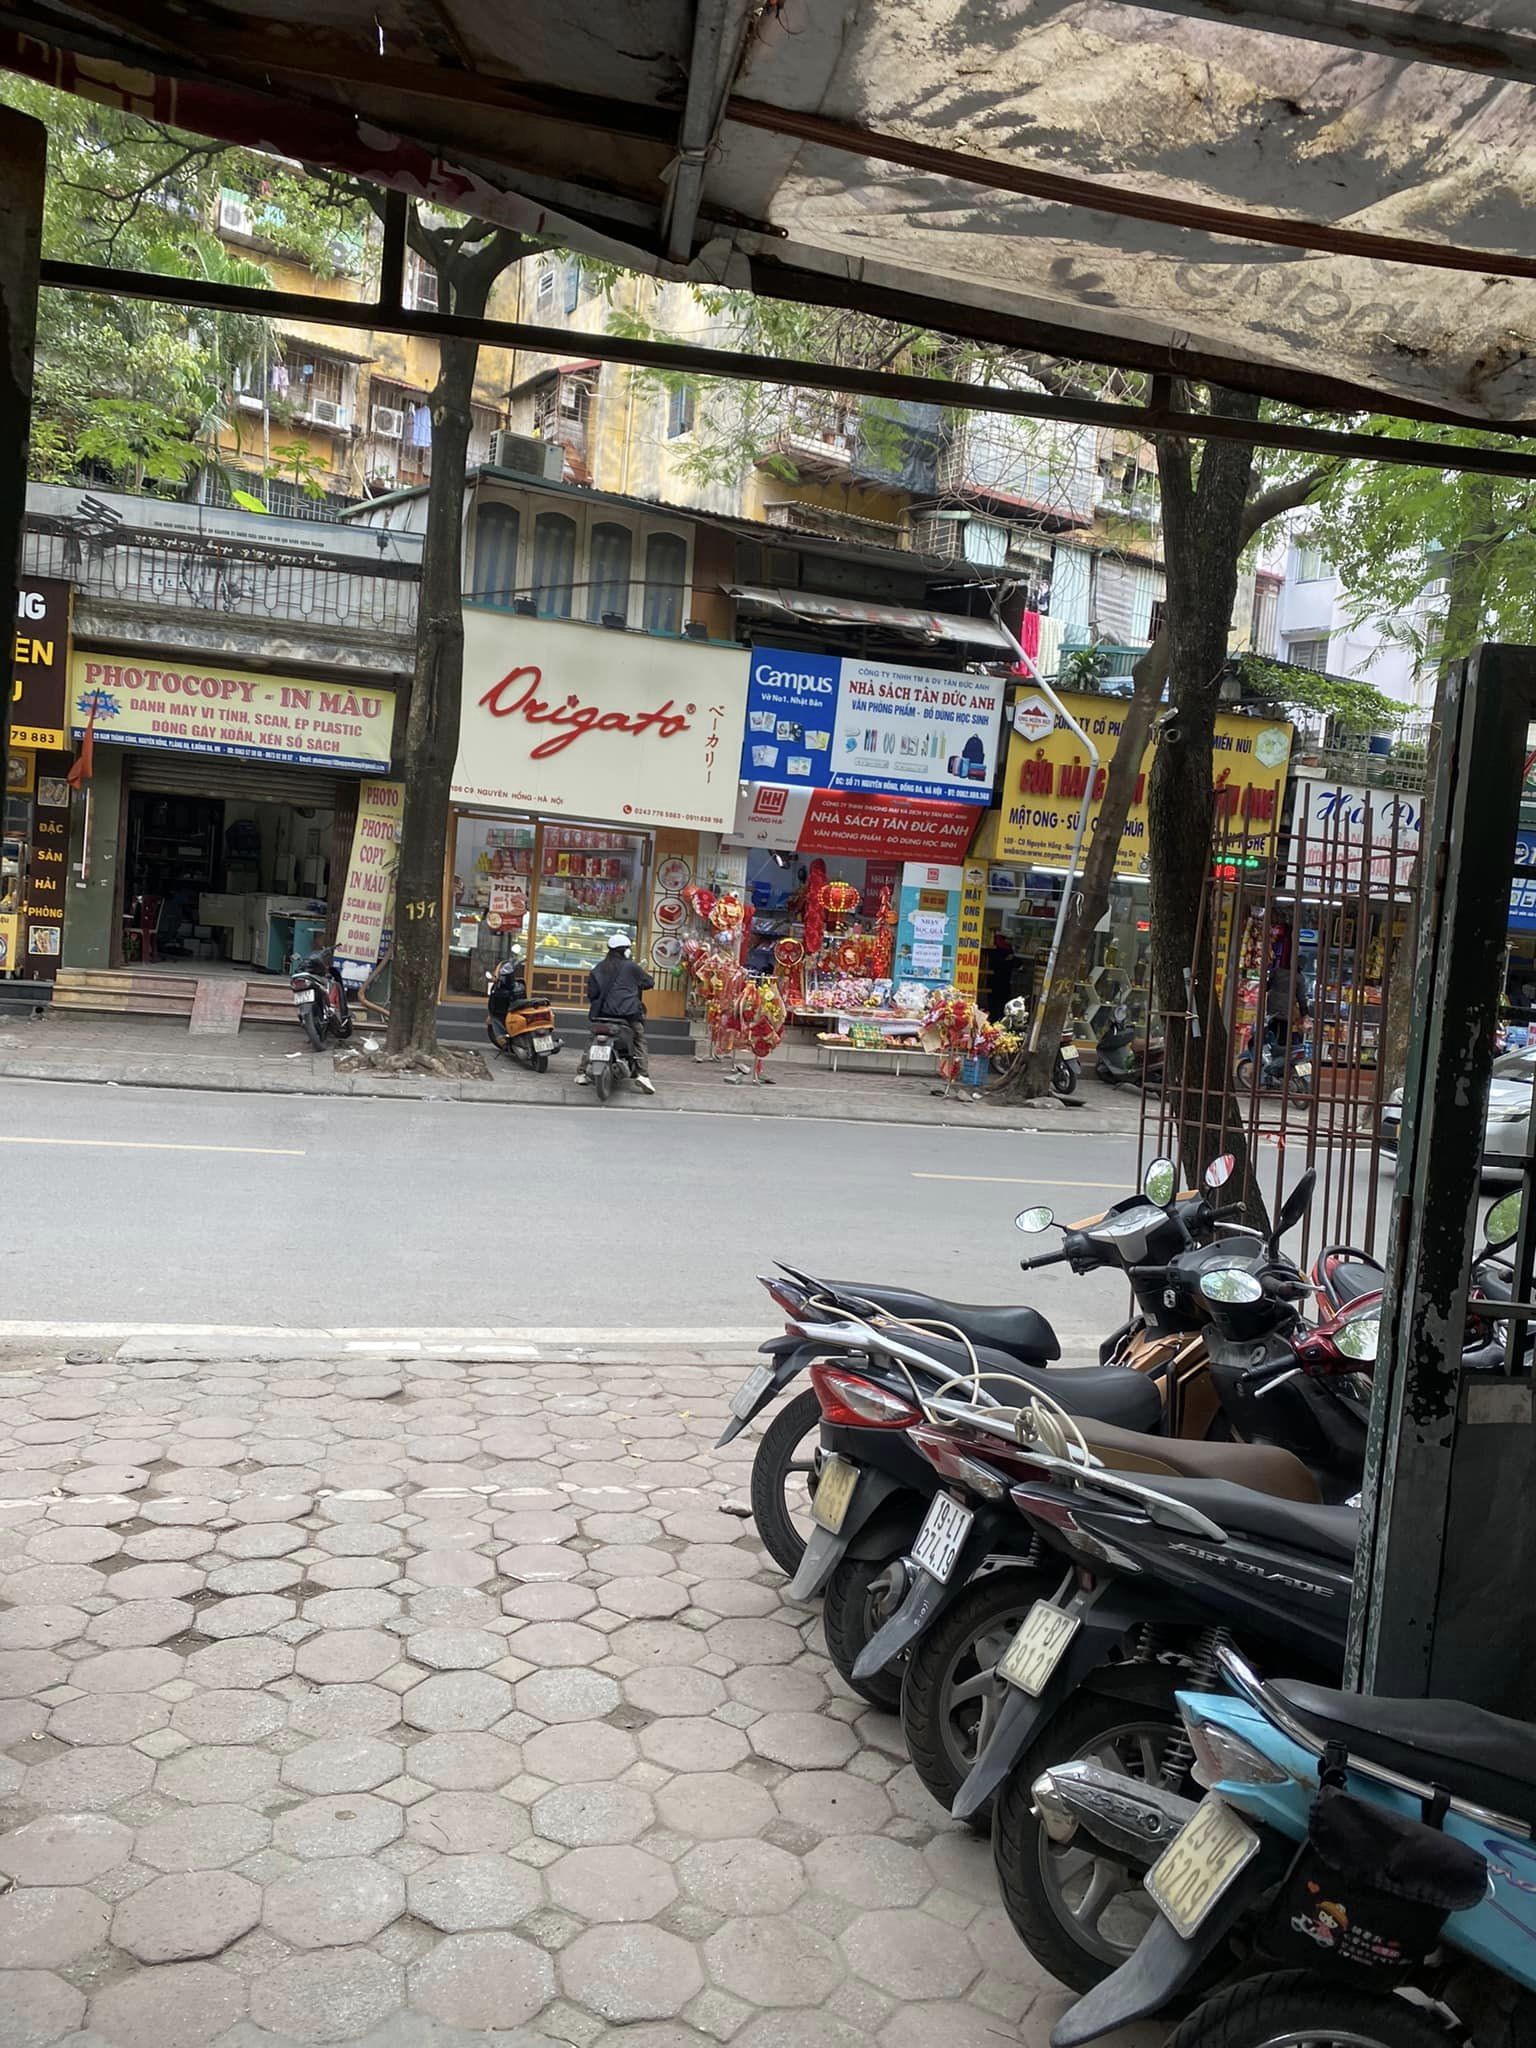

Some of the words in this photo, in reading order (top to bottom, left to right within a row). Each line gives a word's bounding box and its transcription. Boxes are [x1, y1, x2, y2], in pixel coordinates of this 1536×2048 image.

[755, 665, 832, 695] Campus
[858, 667, 880, 677] CÔNG
[893, 673, 912, 681] TNHH
[943, 677, 957, 687] TÂN
[975, 683, 990, 691] ANH
[85, 662, 259, 702] PHOTOCOPY
[280, 687, 314, 710] IN
[319, 690, 383, 718] MÀU
[849, 679, 875, 696] NHÀ
[879, 683, 910, 699] SÁCH
[914, 687, 939, 703] TÂN
[942, 689, 966, 707] ĐỨC
[970, 696, 996, 710] ANH
[790, 697, 807, 707] Nhật
[809, 699, 822, 707] Bản
[478, 666, 690, 760] Origato
[971, 714, 989, 725] SINH
[202, 707, 214, 719] VI
[255, 713, 291, 729] SCAN,
[313, 720, 363, 737] PLASTIC
[1080, 717, 1090, 732] TY
[31, 732, 55, 744] 883
[705, 704, 725, 784] ベーカリー
[1236, 736, 1252, 753] NÚI
[366, 787, 399, 807] PHOTO
[39, 820, 64, 835] ĐẶC
[360, 819, 393, 840] PHOTO
[810, 810, 839, 824] NHÀ
[844, 813, 879, 828] SÁCH
[882, 817, 908, 831] TÂN
[941, 826, 969, 836] ANH
[1009, 805, 1031, 830] MẬT
[1033, 811, 1058, 828] ONG
[1122, 817, 1144, 838] HÚA
[37, 848, 63, 862] SẢN
[360, 845, 386, 866] COPY
[35, 876, 56, 890] HẢI
[350, 871, 360, 888] IN
[365, 870, 386, 893] MÀU
[494, 884, 521, 892] PIZZA
[347, 897, 365, 910] SCAN
[965, 888, 981, 902] MẬT
[28, 906, 64, 919] PHÒNG
[352, 912, 380, 927] PLASTIC
[964, 907, 980, 916] ONG
[962, 922, 977, 932] HOA
[958, 971, 974, 984] HOA
[933, 1499, 968, 1542] 19-L1
[916, 1527, 957, 1577] 274.19
